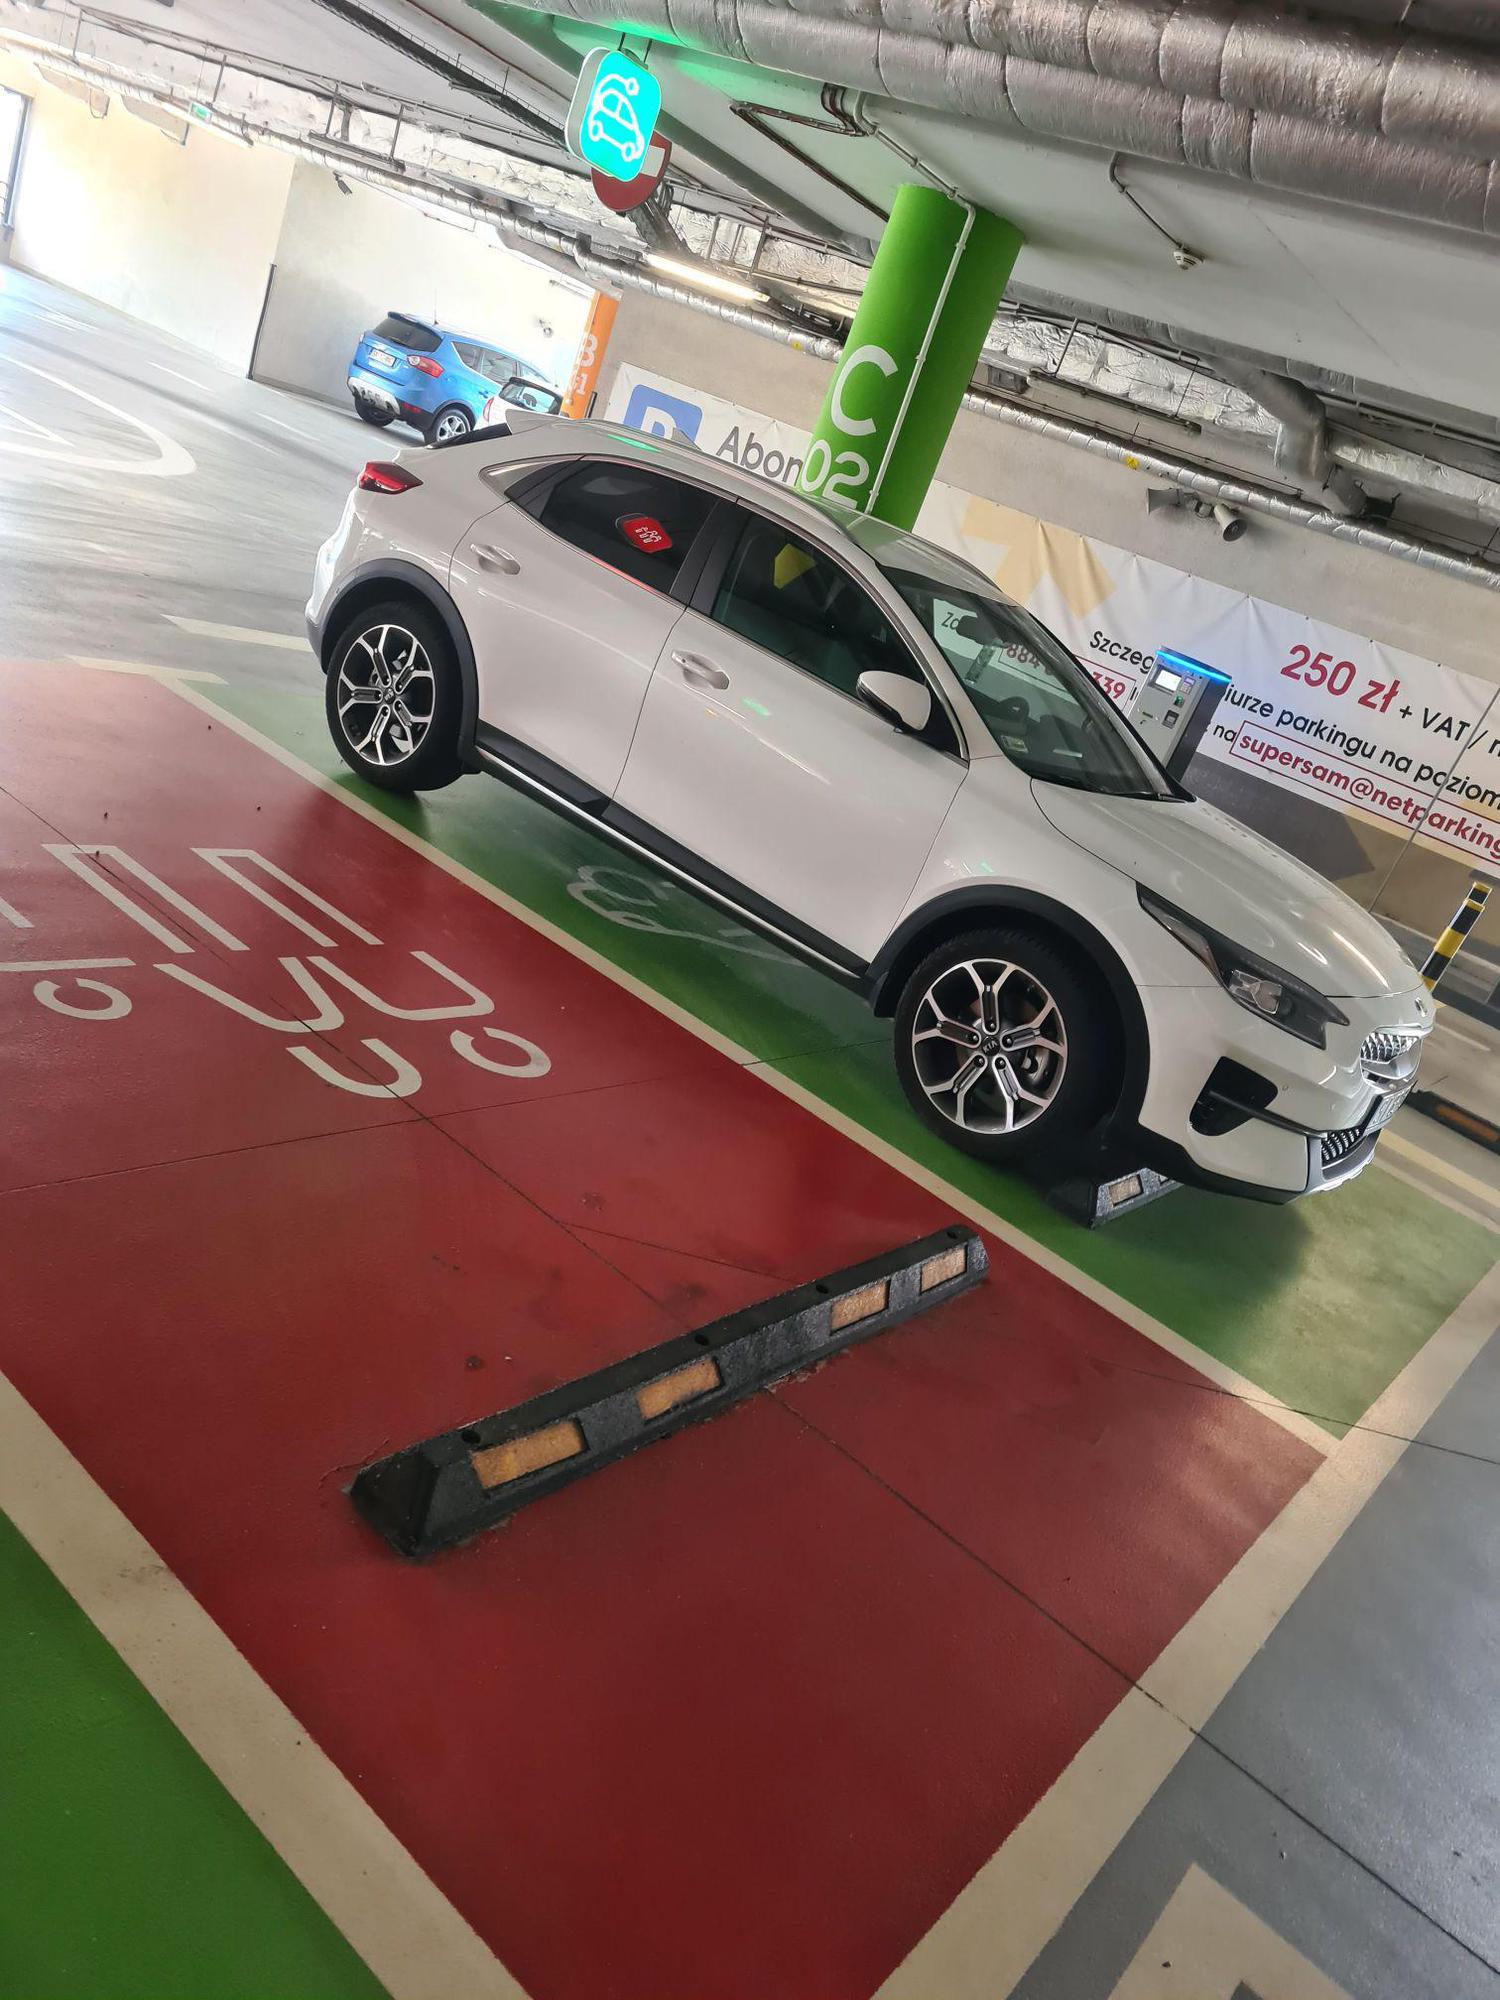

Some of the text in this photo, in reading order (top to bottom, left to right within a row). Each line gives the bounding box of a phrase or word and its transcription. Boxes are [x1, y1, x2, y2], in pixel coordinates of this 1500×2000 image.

[830, 344, 899, 437] C
[715, 426, 804, 487] Abon
[801, 439, 870, 510] 02
[1223, 684, 1274, 718] iurze
[1275, 709, 1377, 760] parkingu
[1380, 749, 1414, 774] na
[1280, 644, 1357, 696] 250
[1358, 679, 1401, 713] zł
[1399, 705, 1413, 719] +
[1422, 707, 1471, 742] VAT
[1213, 724, 1237, 743] na
